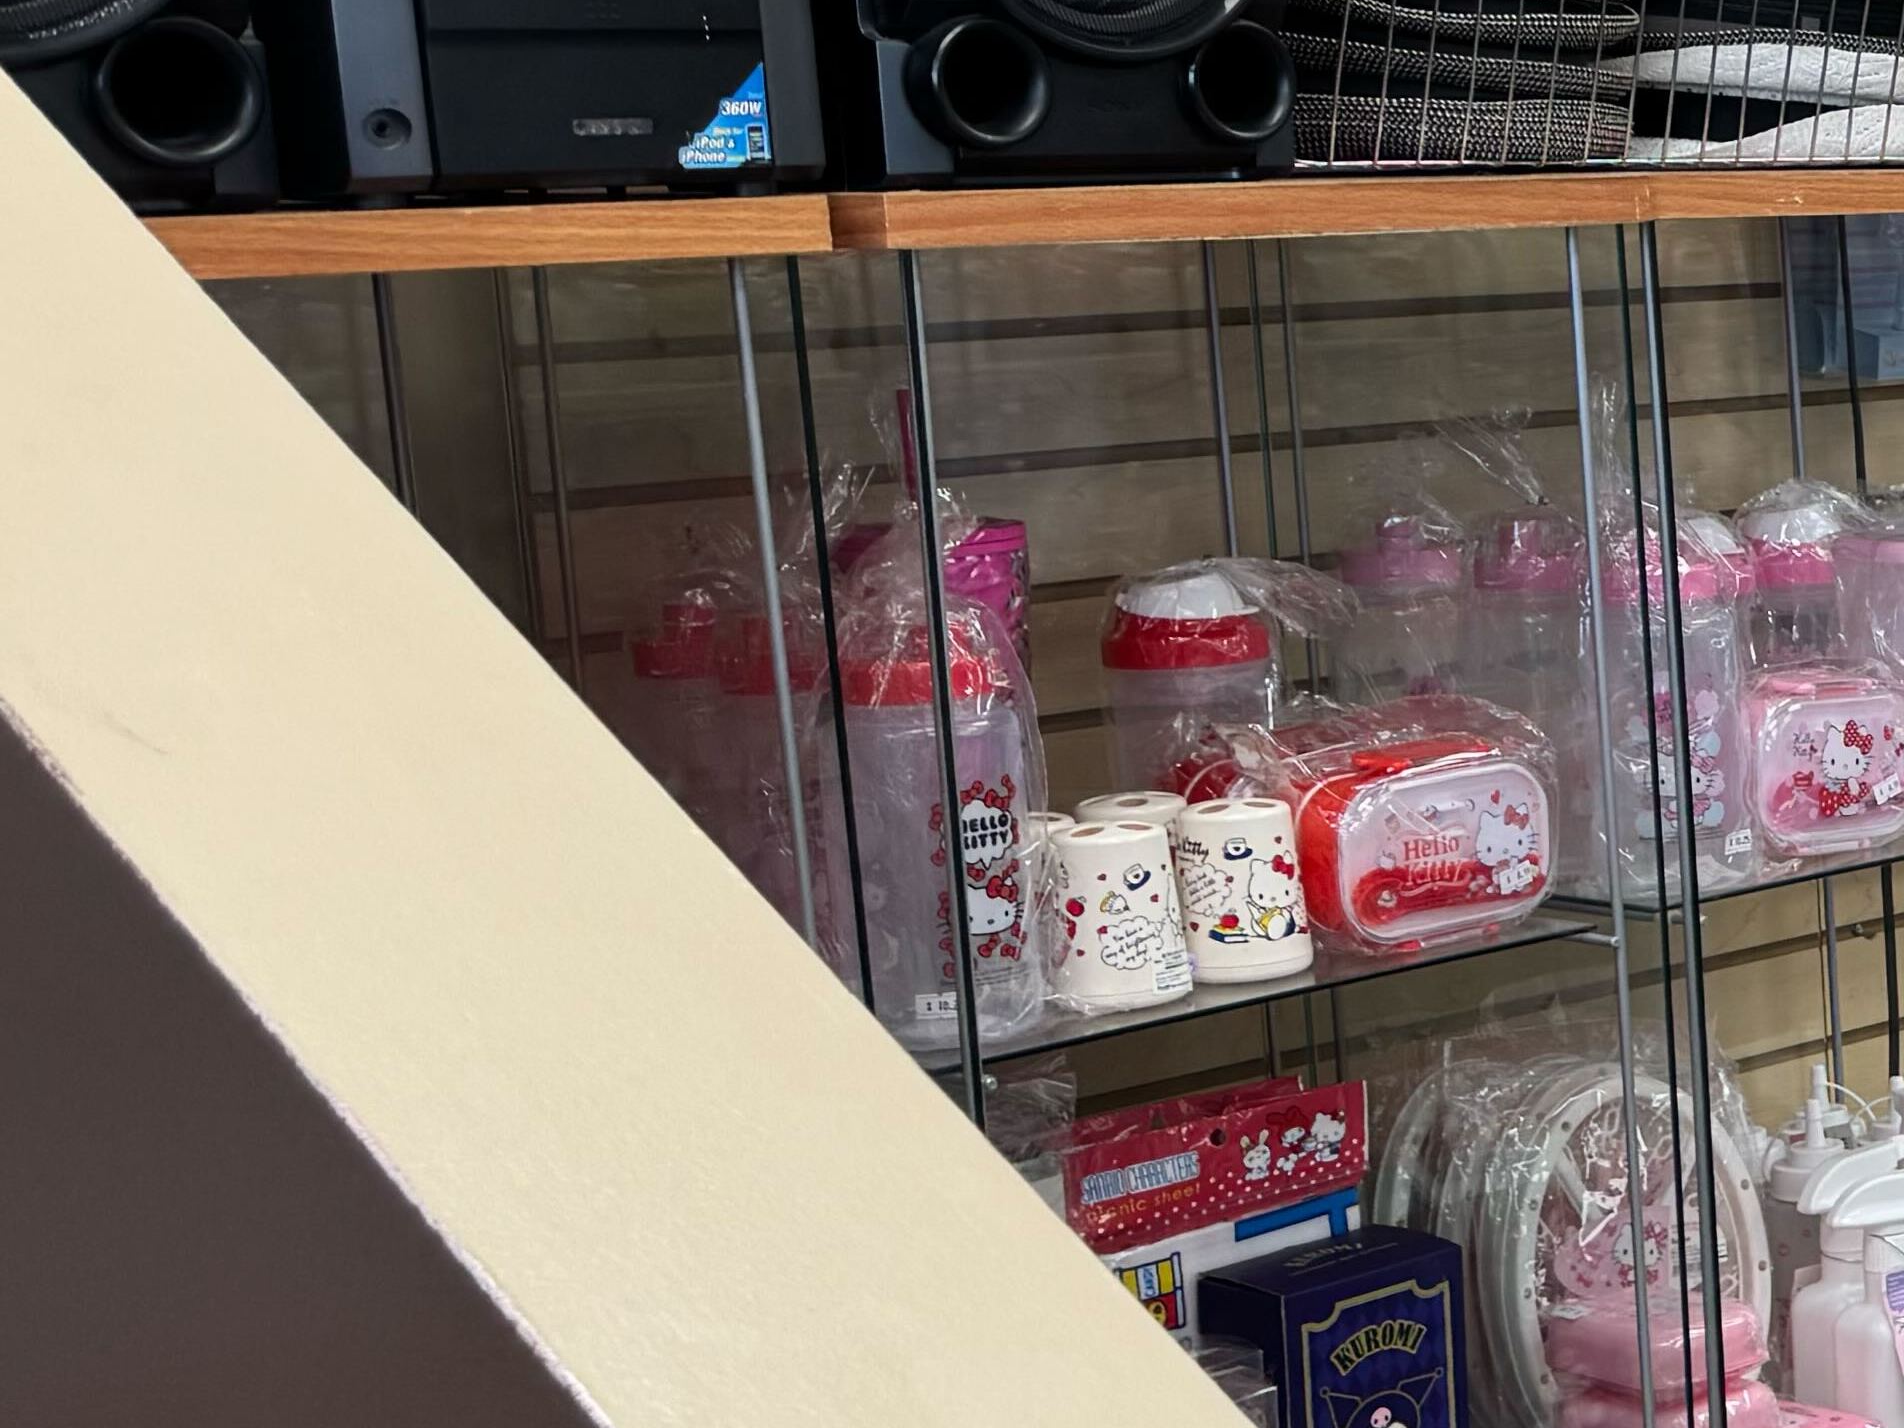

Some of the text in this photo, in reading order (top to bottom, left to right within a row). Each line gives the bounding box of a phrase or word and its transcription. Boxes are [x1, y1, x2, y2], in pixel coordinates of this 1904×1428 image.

[721, 101, 762, 116] 360W
[694, 137, 724, 149] iPod
[682, 150, 726, 164] iPhone
[1403, 835, 1463, 859] Hello
[1126, 1151, 1200, 1194] CHARACTERS
[1154, 1183, 1200, 1207] sheet
[1329, 1319, 1428, 1376] KUROMI
